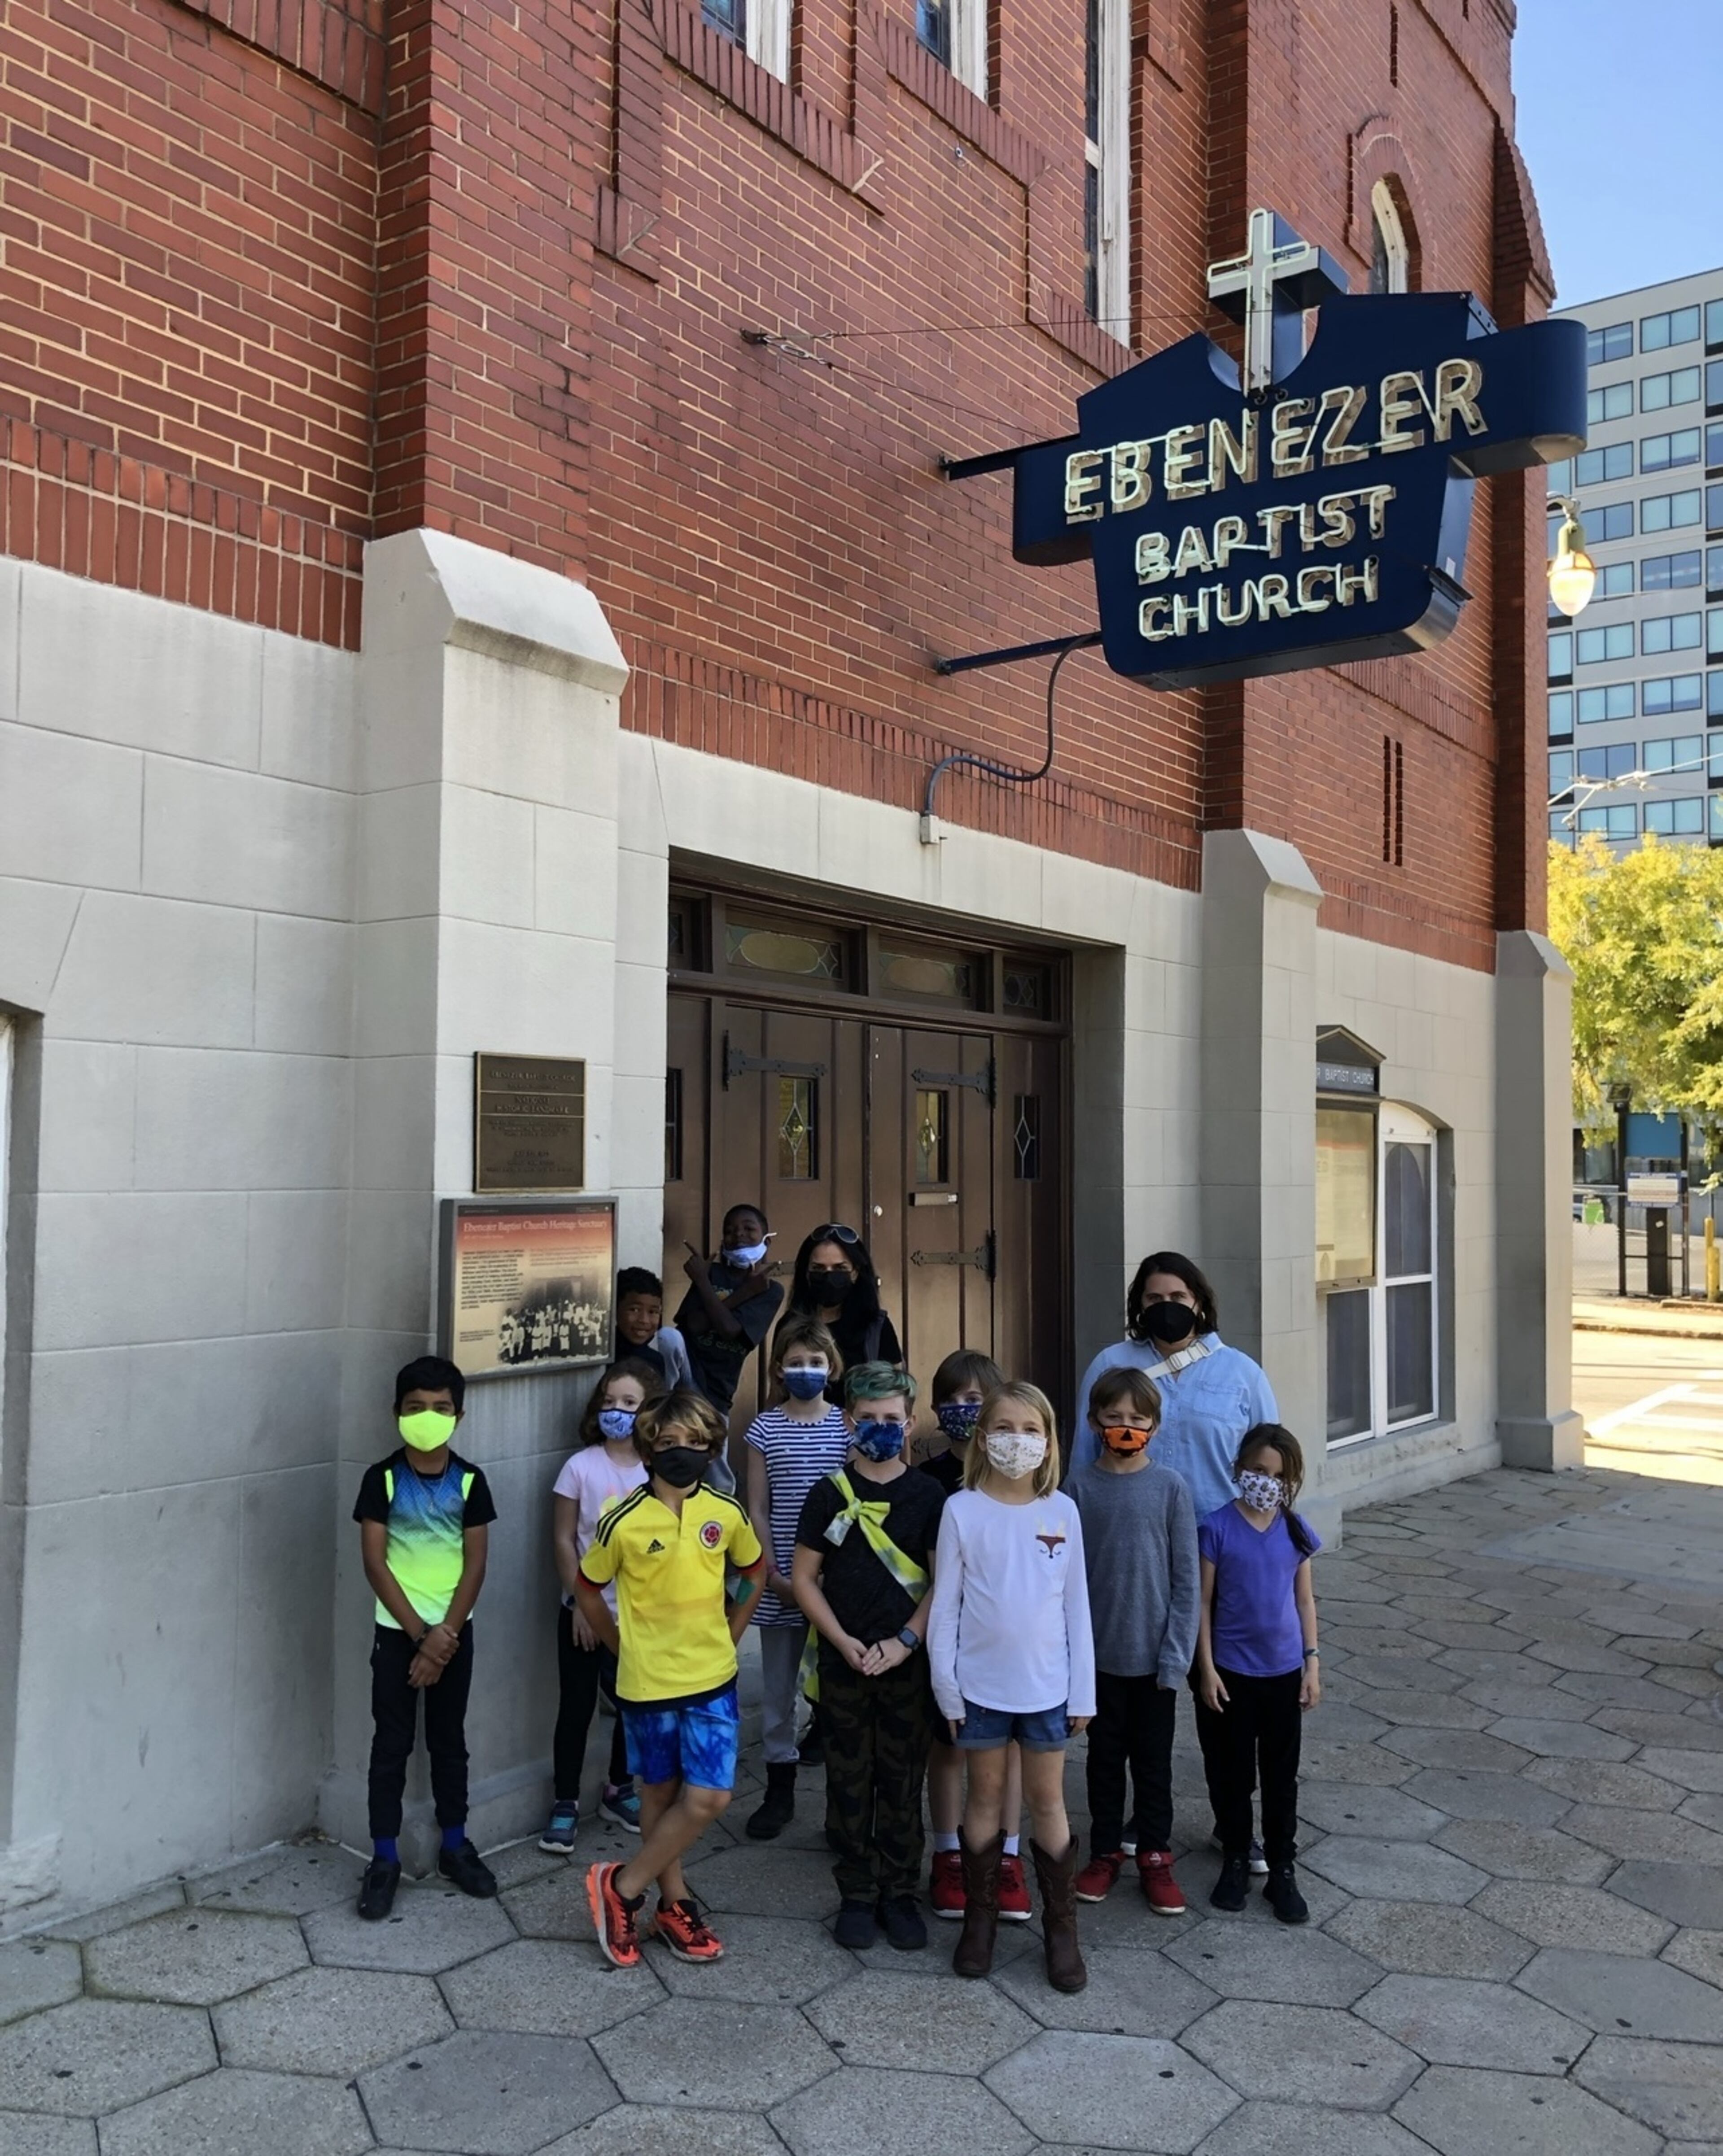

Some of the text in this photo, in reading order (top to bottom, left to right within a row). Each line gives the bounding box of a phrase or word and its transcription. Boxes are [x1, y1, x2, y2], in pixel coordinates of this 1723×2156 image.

[1065, 358, 1488, 525] EBENEZER
[1135, 485, 1396, 585] BAPTIST
[1138, 555, 1380, 642] CHURCH
[1325, 1068, 1349, 1082] BAPTIST
[1352, 1071, 1373, 1085] CHURCH
